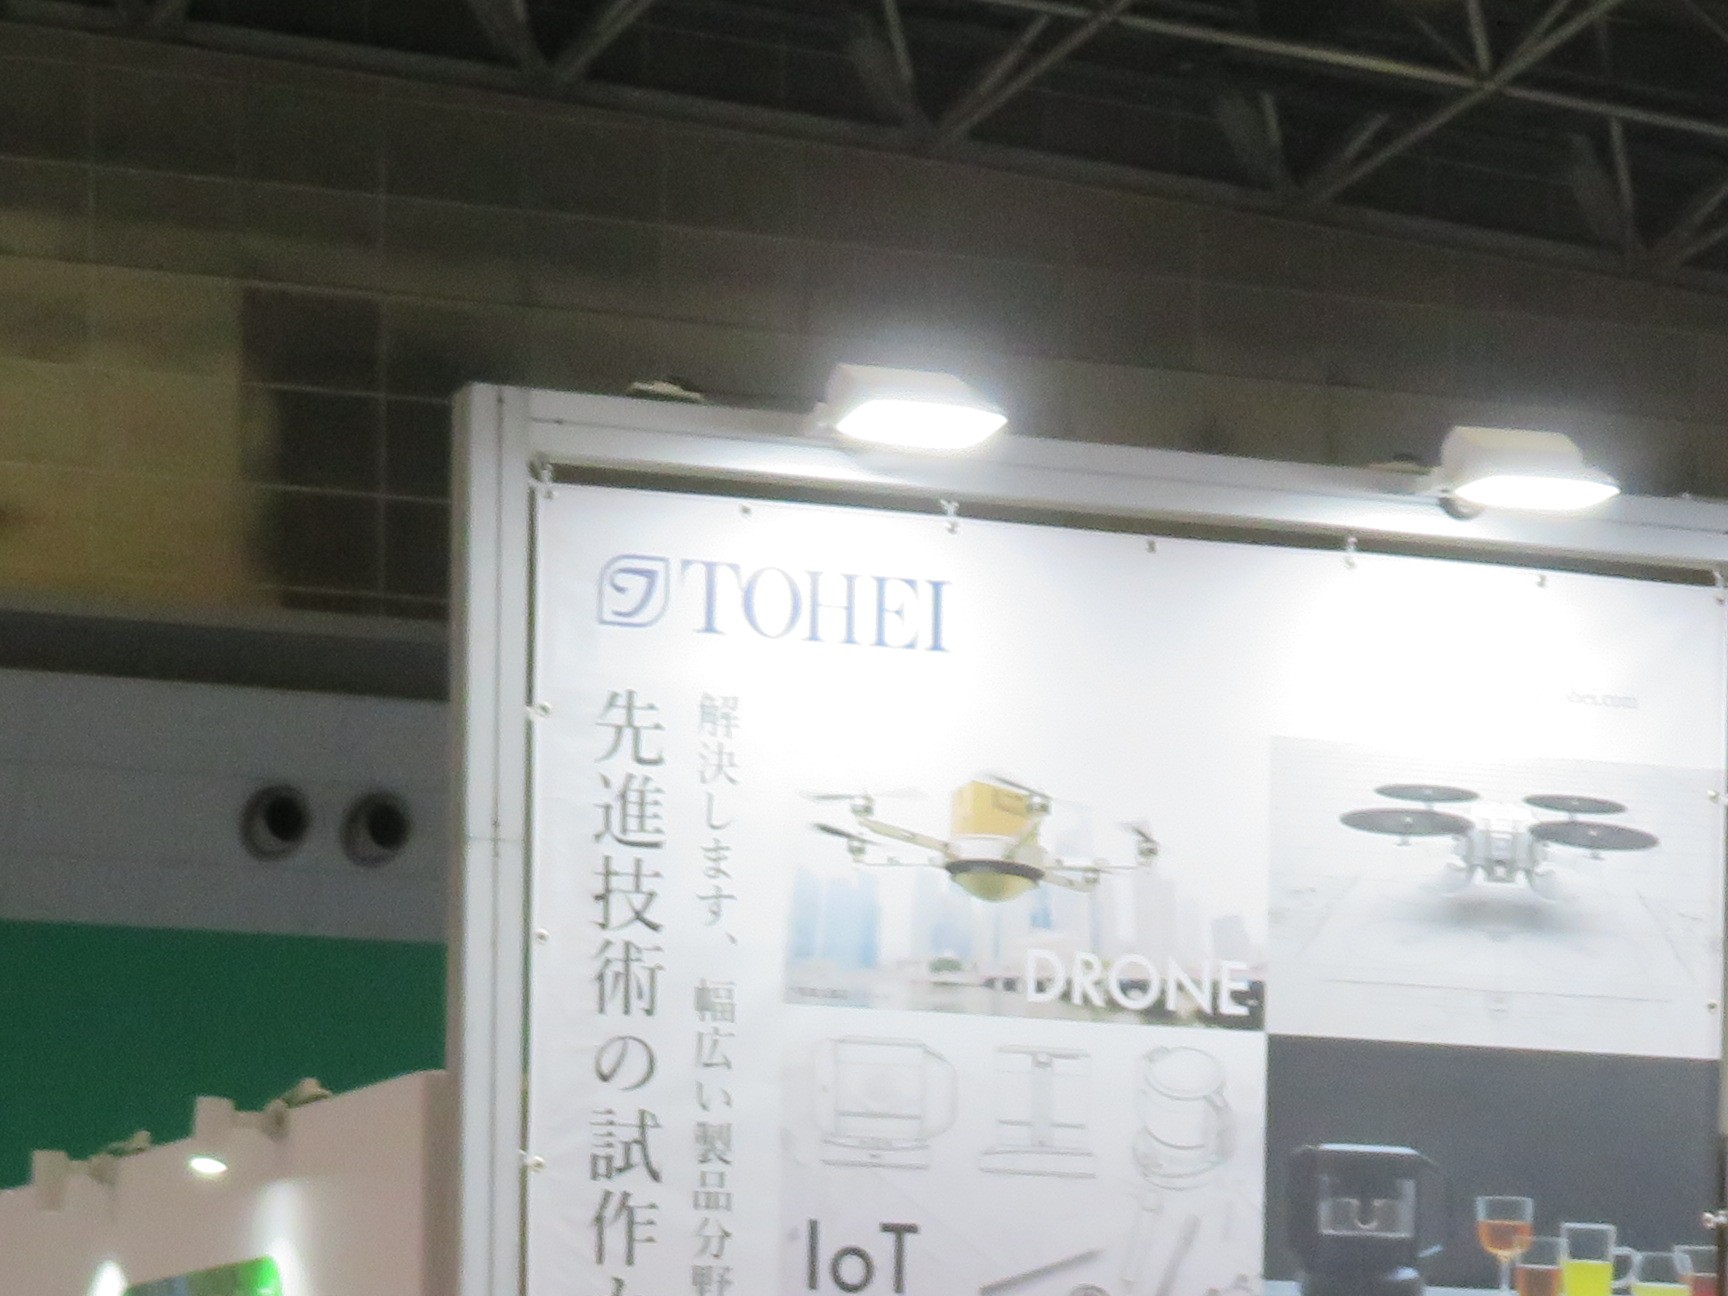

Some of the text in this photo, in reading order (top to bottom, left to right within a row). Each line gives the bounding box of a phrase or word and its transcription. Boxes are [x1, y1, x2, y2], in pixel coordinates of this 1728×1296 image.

[680, 558, 953, 653] TOHEI
[1025, 949, 1251, 1016] DRONE
[807, 1217, 920, 1295] IoT
